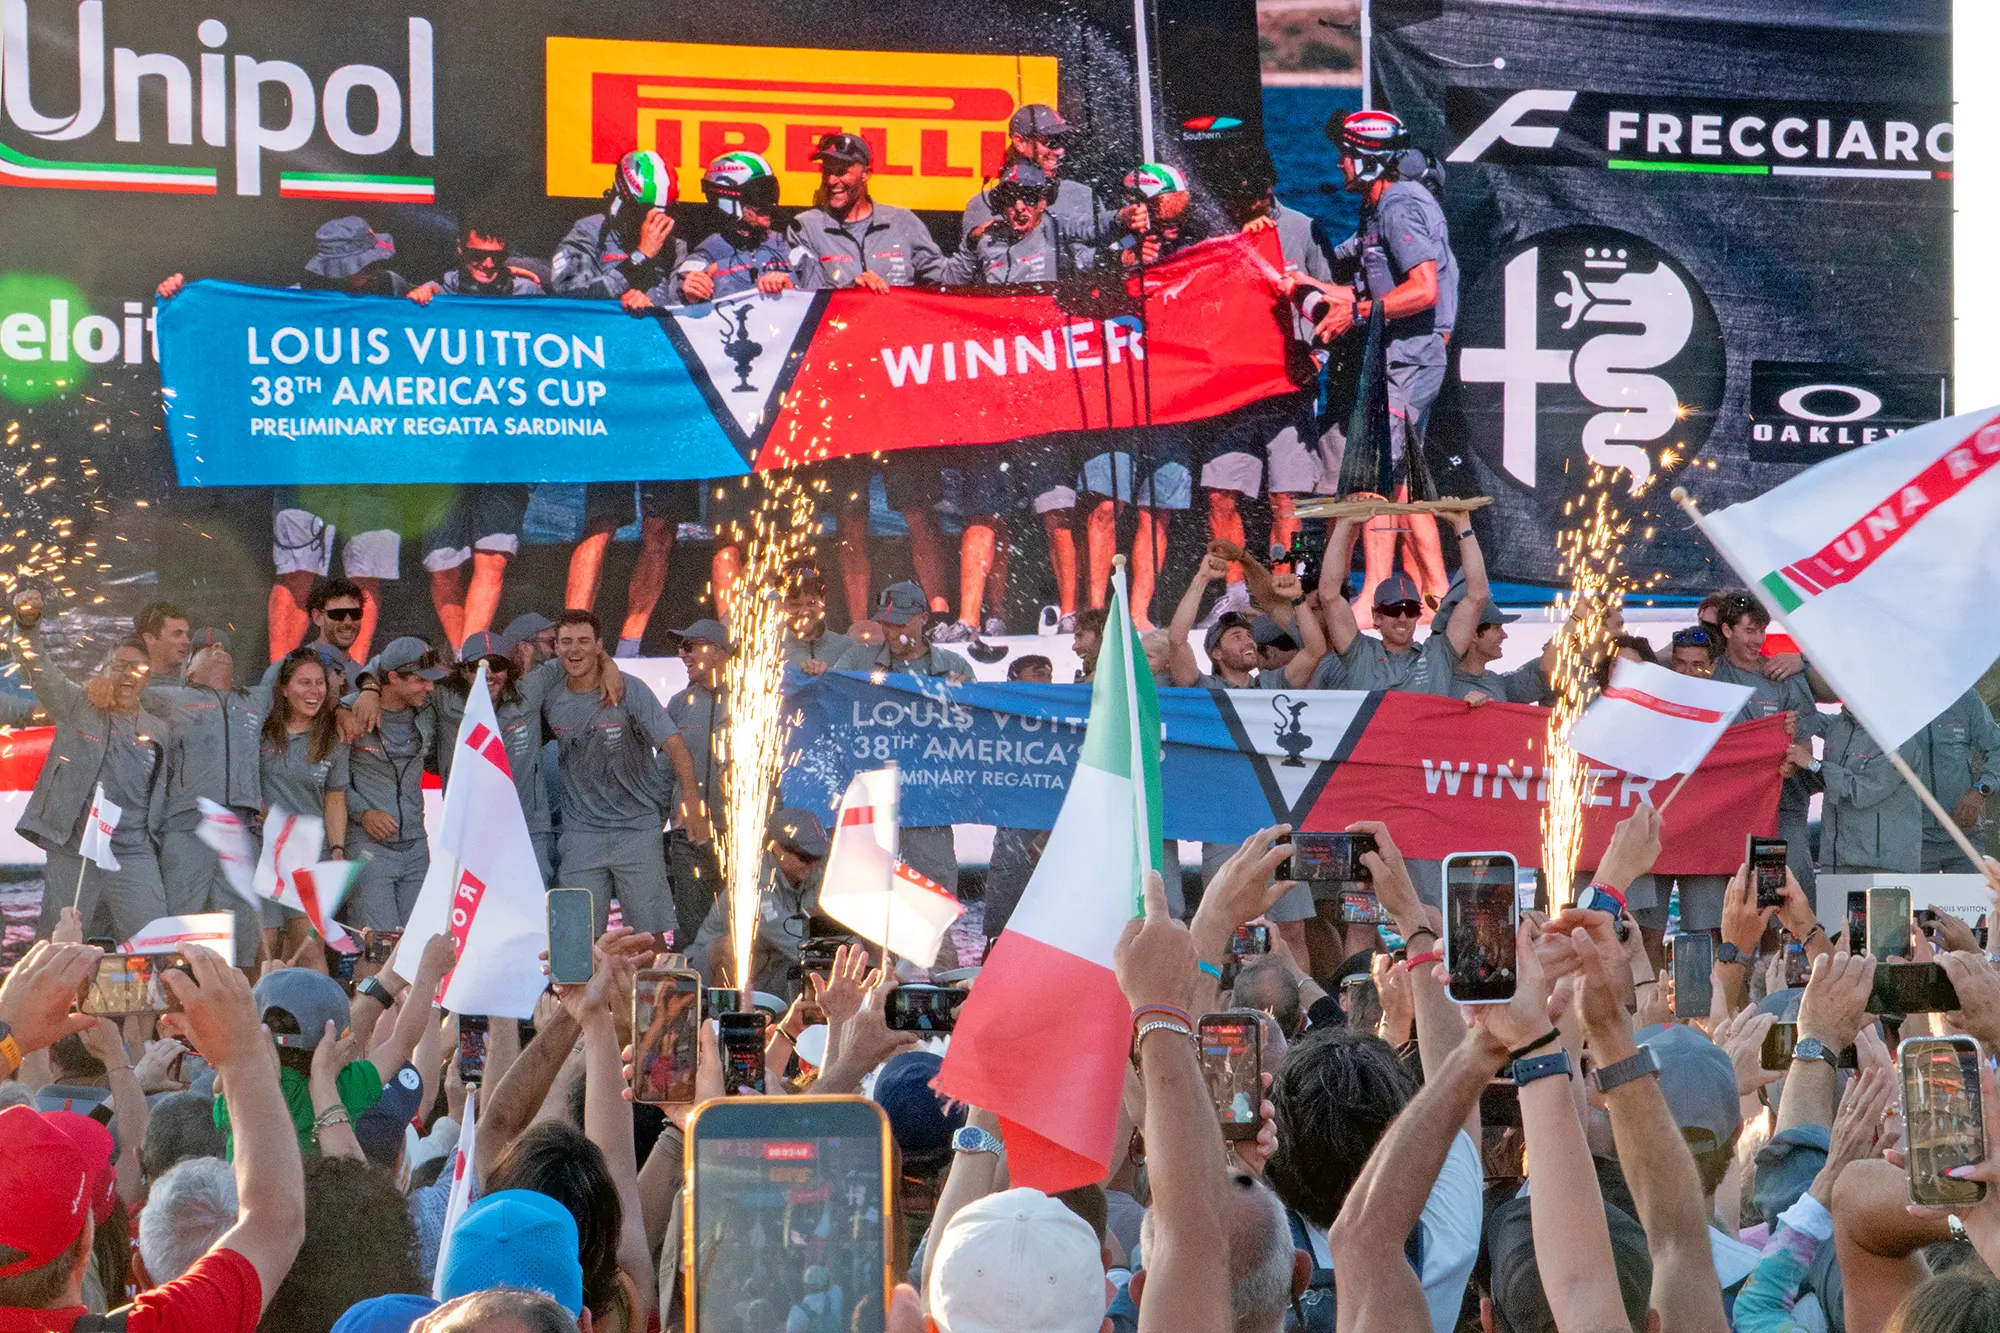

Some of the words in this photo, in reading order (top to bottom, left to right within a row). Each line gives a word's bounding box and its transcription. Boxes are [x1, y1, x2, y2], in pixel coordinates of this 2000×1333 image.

[1, 0, 434, 196] Unipol
[592, 72, 1014, 179] PIRELLI
[1182, 131, 1221, 141] Southern
[247, 326, 391, 365] LOUIS
[403, 327, 606, 370] VUITTON
[881, 314, 1146, 388] WINNER
[250, 375, 322, 406] 38TH
[331, 375, 528, 407] AMERICA'S
[537, 378, 607, 407] CUP
[250, 416, 398, 437] PRELIMINARY
[403, 416, 499, 436] REGATTA
[504, 417, 609, 437] SARDINIA
[1812, 484, 1930, 578] LUNA
[852, 700, 975, 730] LOUIS
[852, 734, 914, 760] 38TH
[982, 771, 1065, 790] REGATTA
[1957, 905, 1988, 913] VUITTON
